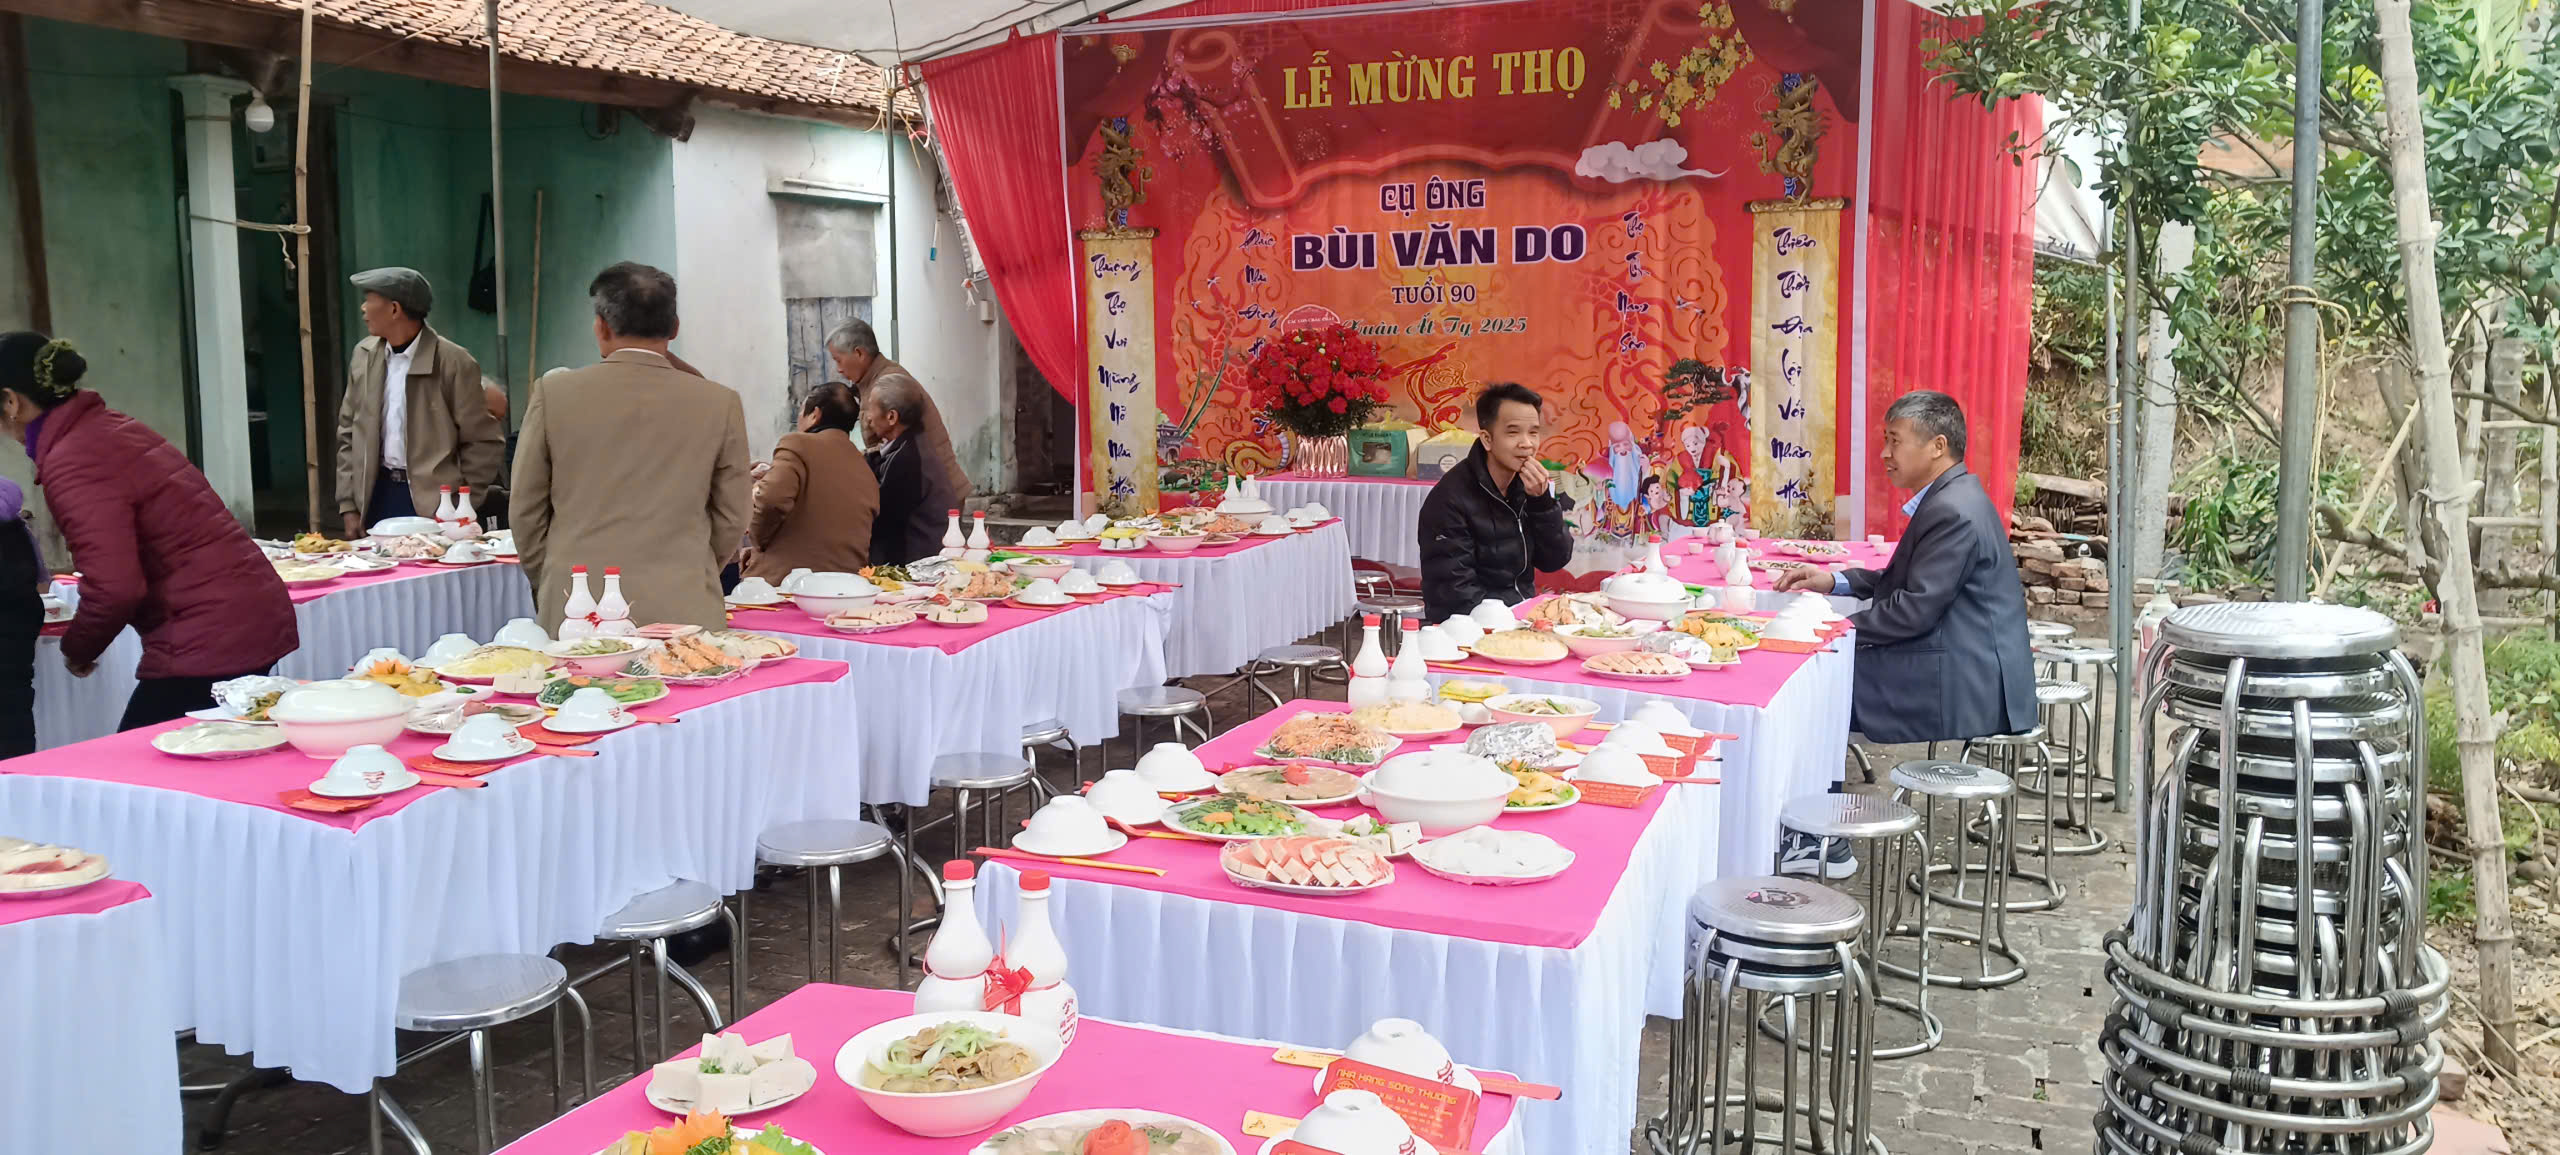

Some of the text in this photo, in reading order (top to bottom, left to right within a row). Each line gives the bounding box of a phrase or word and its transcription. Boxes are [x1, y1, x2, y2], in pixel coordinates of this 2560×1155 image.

[1283, 47, 1586, 109] LỄ MỪNG THỌ
[1380, 175, 1486, 218] CỤ ÔNG
[1292, 222, 1586, 271] BÙI VĂN DO
[1773, 227, 1816, 255] Thiên
[1391, 276, 1476, 304] TUỔI 90
[1104, 328, 1127, 349] Vui
[1406, 313, 1434, 336] Ất
[1479, 317, 1528, 333] 2025
[1771, 437, 1812, 464] Nhân
